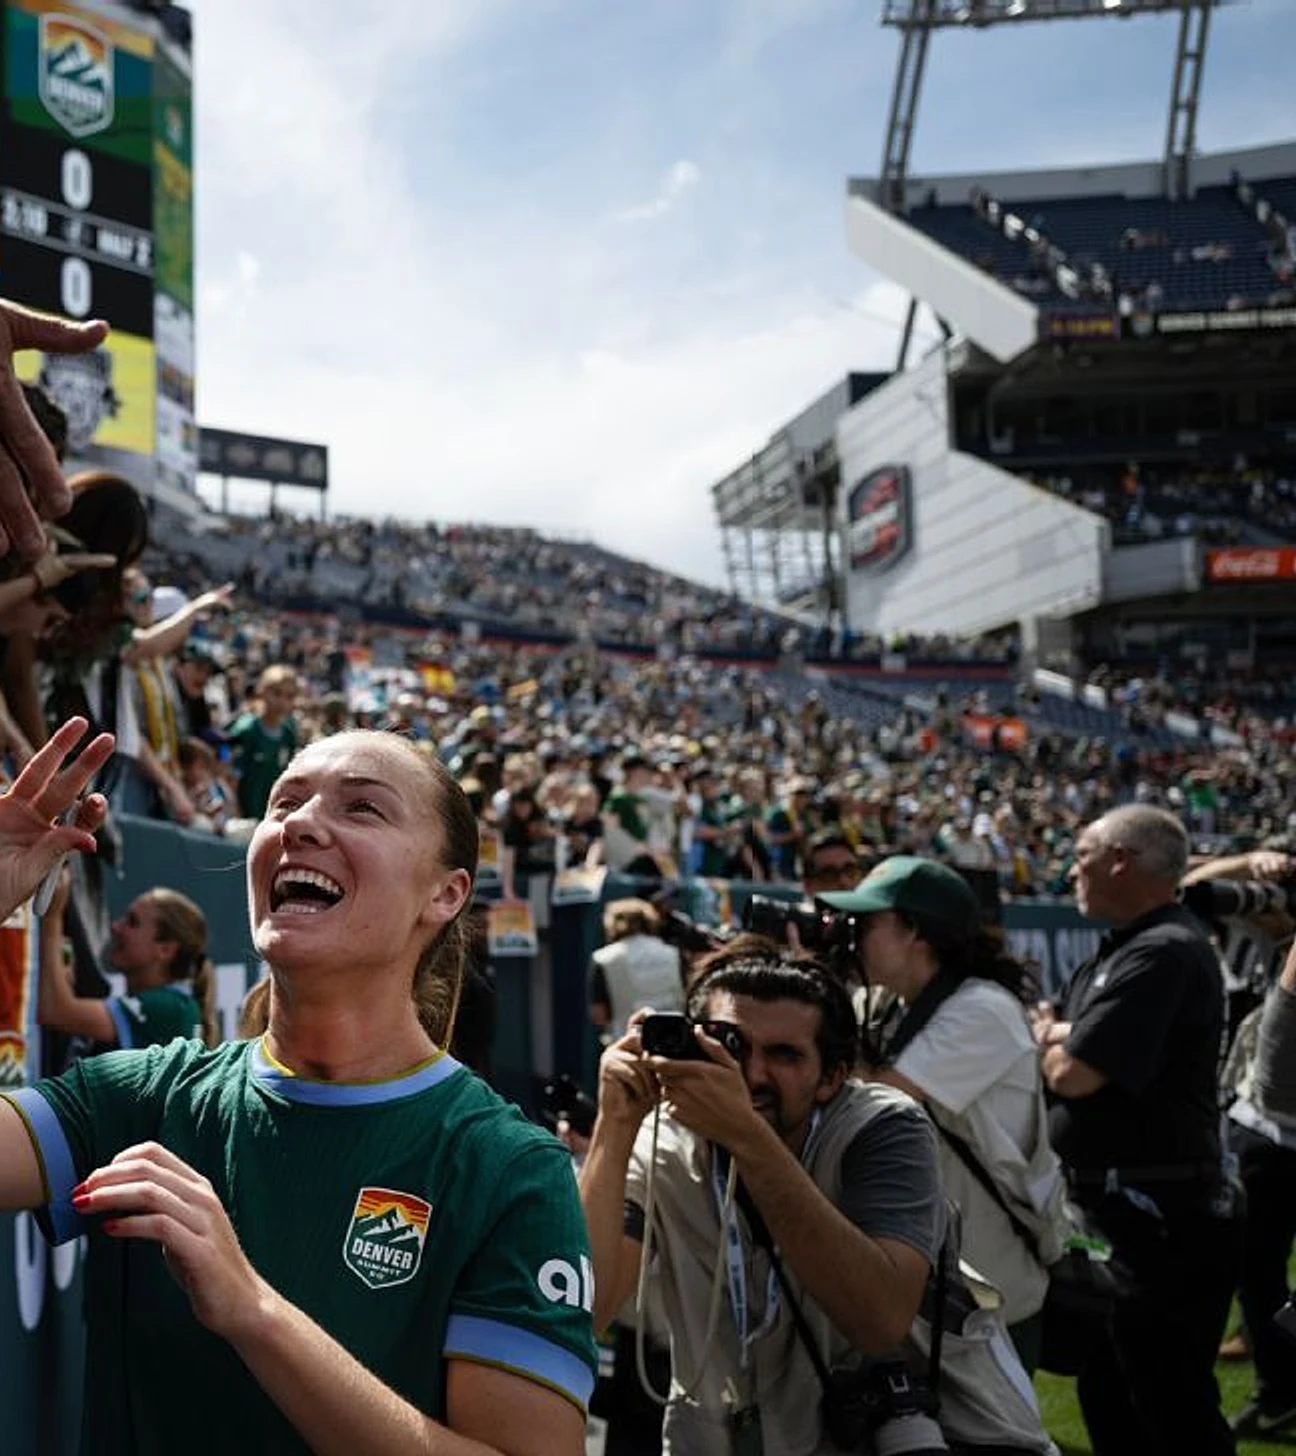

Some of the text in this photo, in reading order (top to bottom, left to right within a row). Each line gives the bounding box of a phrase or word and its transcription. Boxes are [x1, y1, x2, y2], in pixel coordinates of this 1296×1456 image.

[61, 149, 92, 210] 0
[61, 256, 92, 317] 0
[352, 1237, 413, 1270] DENVER
[537, 1253, 596, 1313] al
